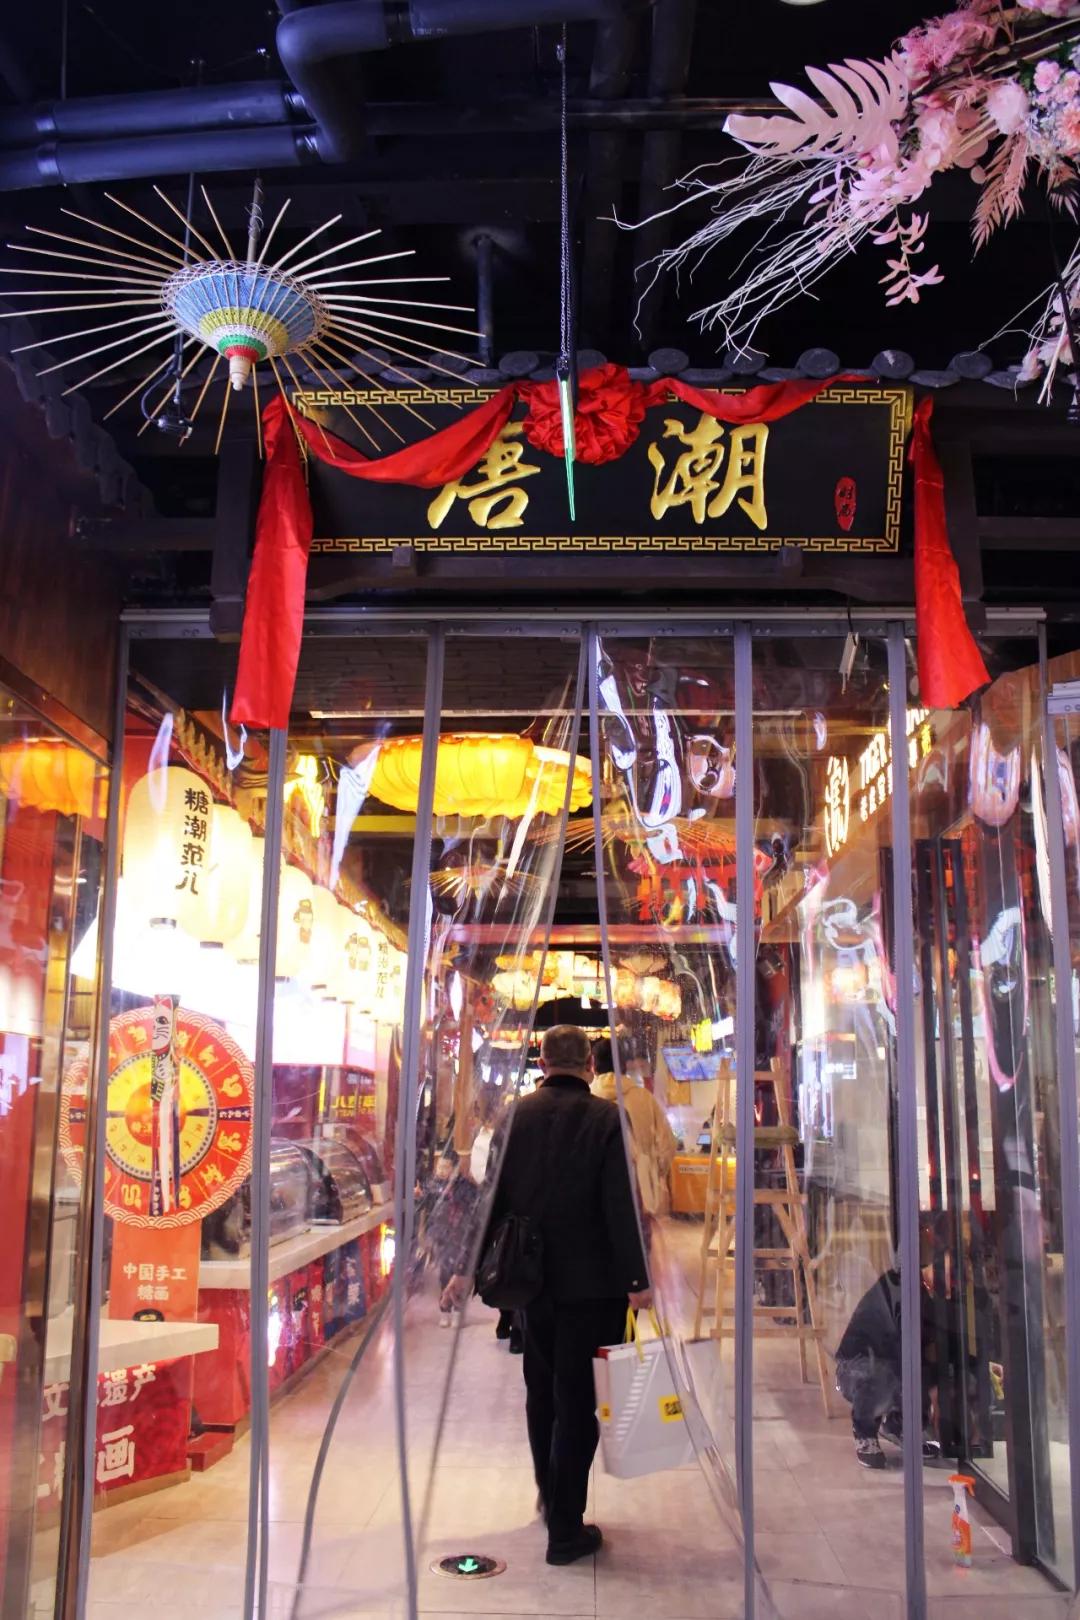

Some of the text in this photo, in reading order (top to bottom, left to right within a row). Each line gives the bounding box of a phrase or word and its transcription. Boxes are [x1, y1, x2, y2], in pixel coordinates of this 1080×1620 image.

[175, 787, 209, 895] 糖潮范儿
[122, 1262, 188, 1281] 中国手工
